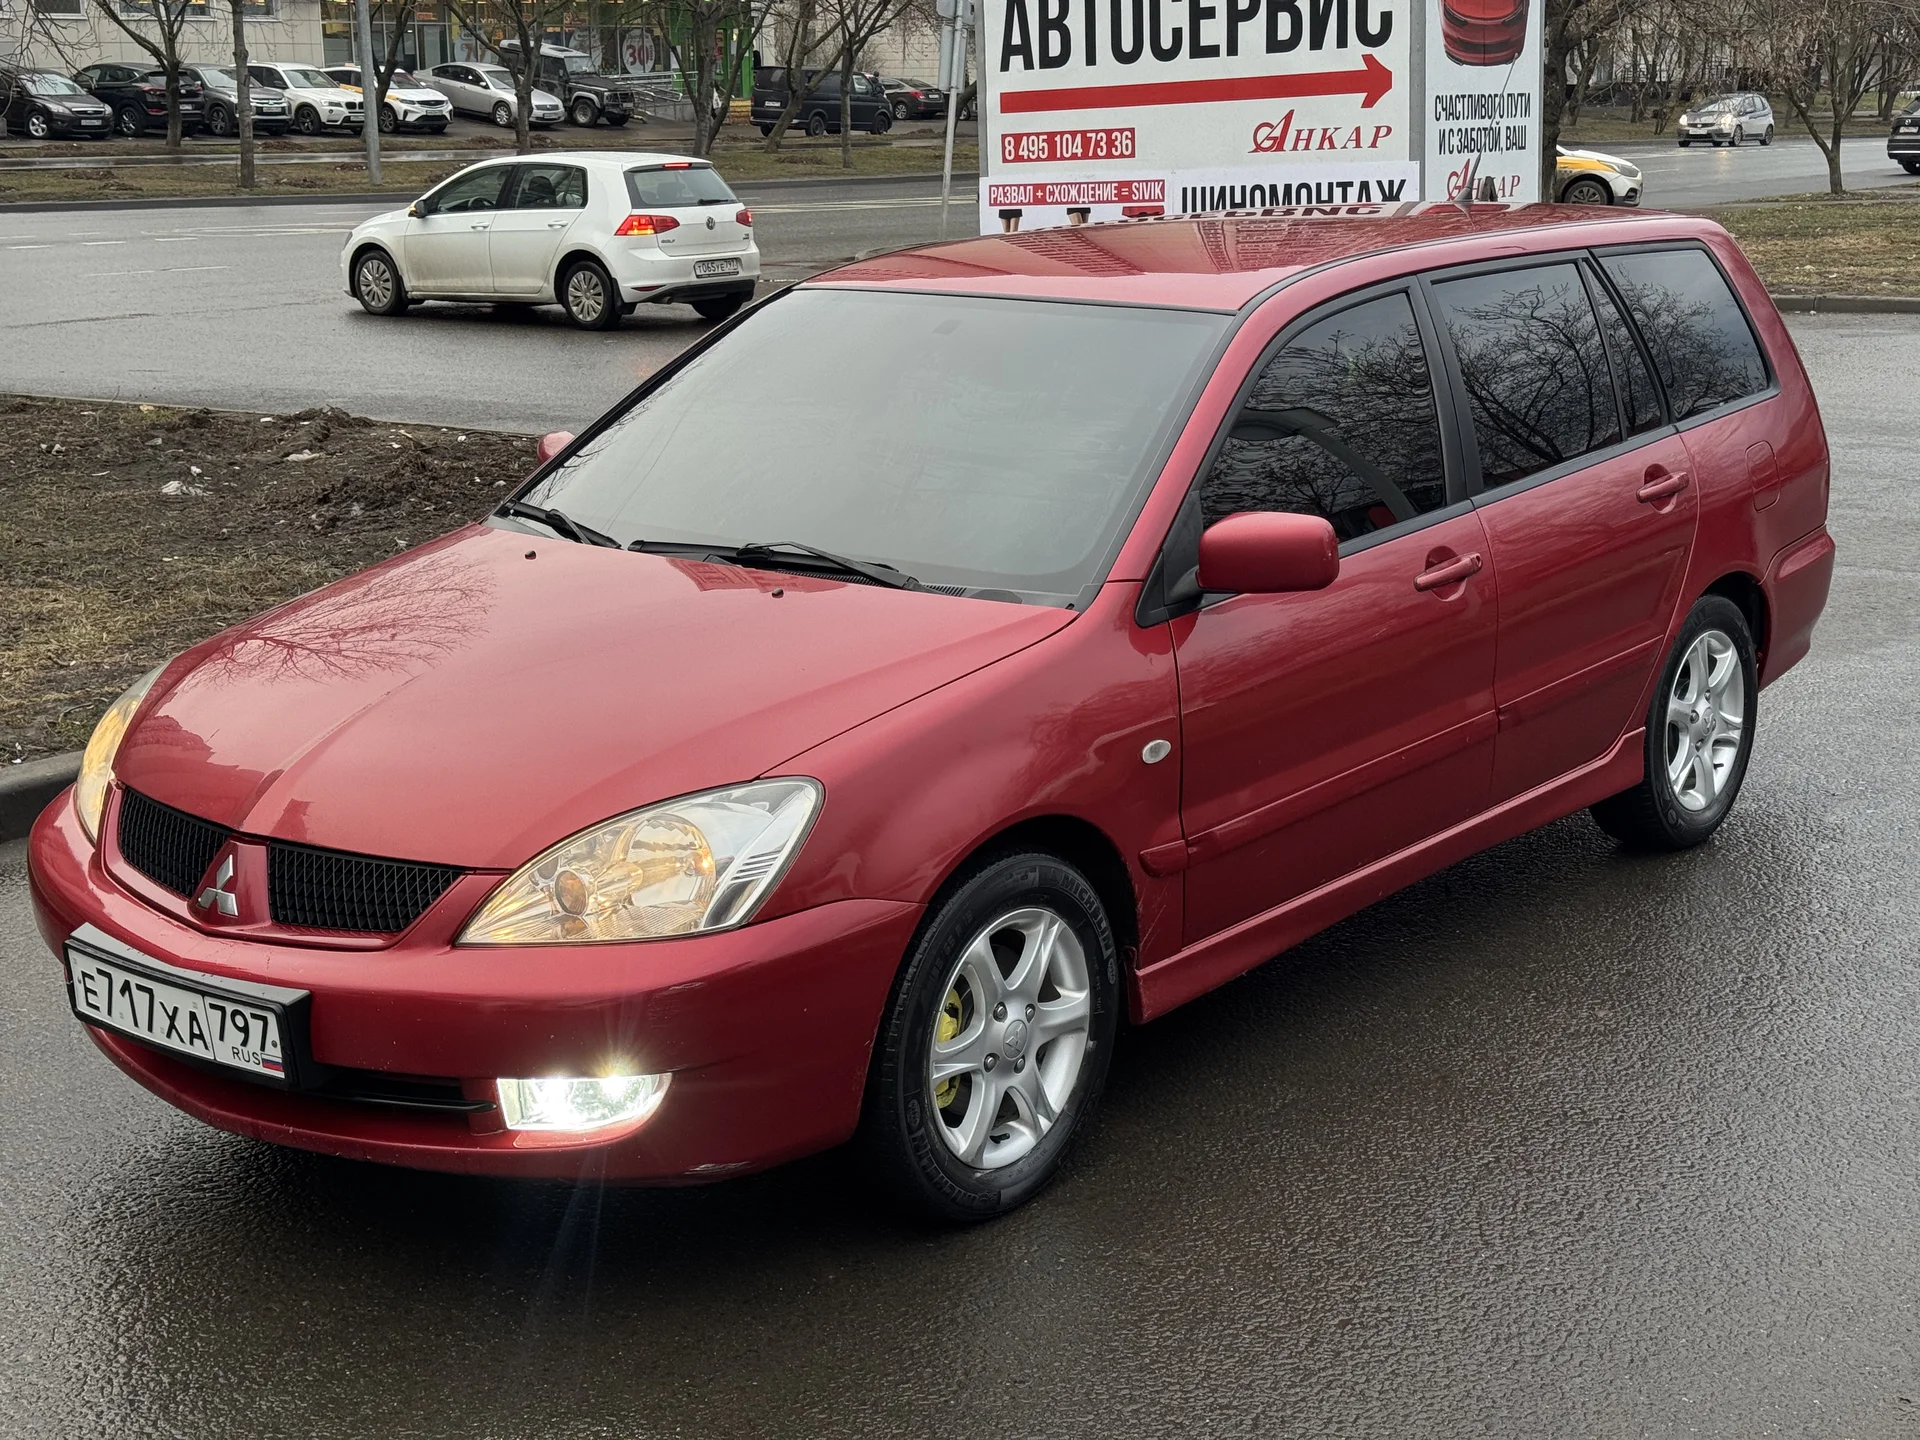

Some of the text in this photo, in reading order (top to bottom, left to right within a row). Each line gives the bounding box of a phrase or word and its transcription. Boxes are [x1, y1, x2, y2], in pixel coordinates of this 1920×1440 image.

[1000, 0, 1393, 72] АВТОСЕРВИС
[1434, 92, 1531, 121] СЧАСТЛИВОГО ПУТИ
[1004, 130, 1132, 160] 8 495 104 73 36
[1248, 109, 1392, 153] АНКАР
[1439, 120, 1527, 155] И С ЗАБОТОЙ, ВАШ
[990, 185, 1033, 204] РАЗВАЛ
[1046, 183, 1118, 203] СХОЖДЕНИЕ
[1131, 181, 1163, 200] SIVIK
[1446, 158, 1521, 201] АНАР
[231, 1046, 261, 1066] RUS
